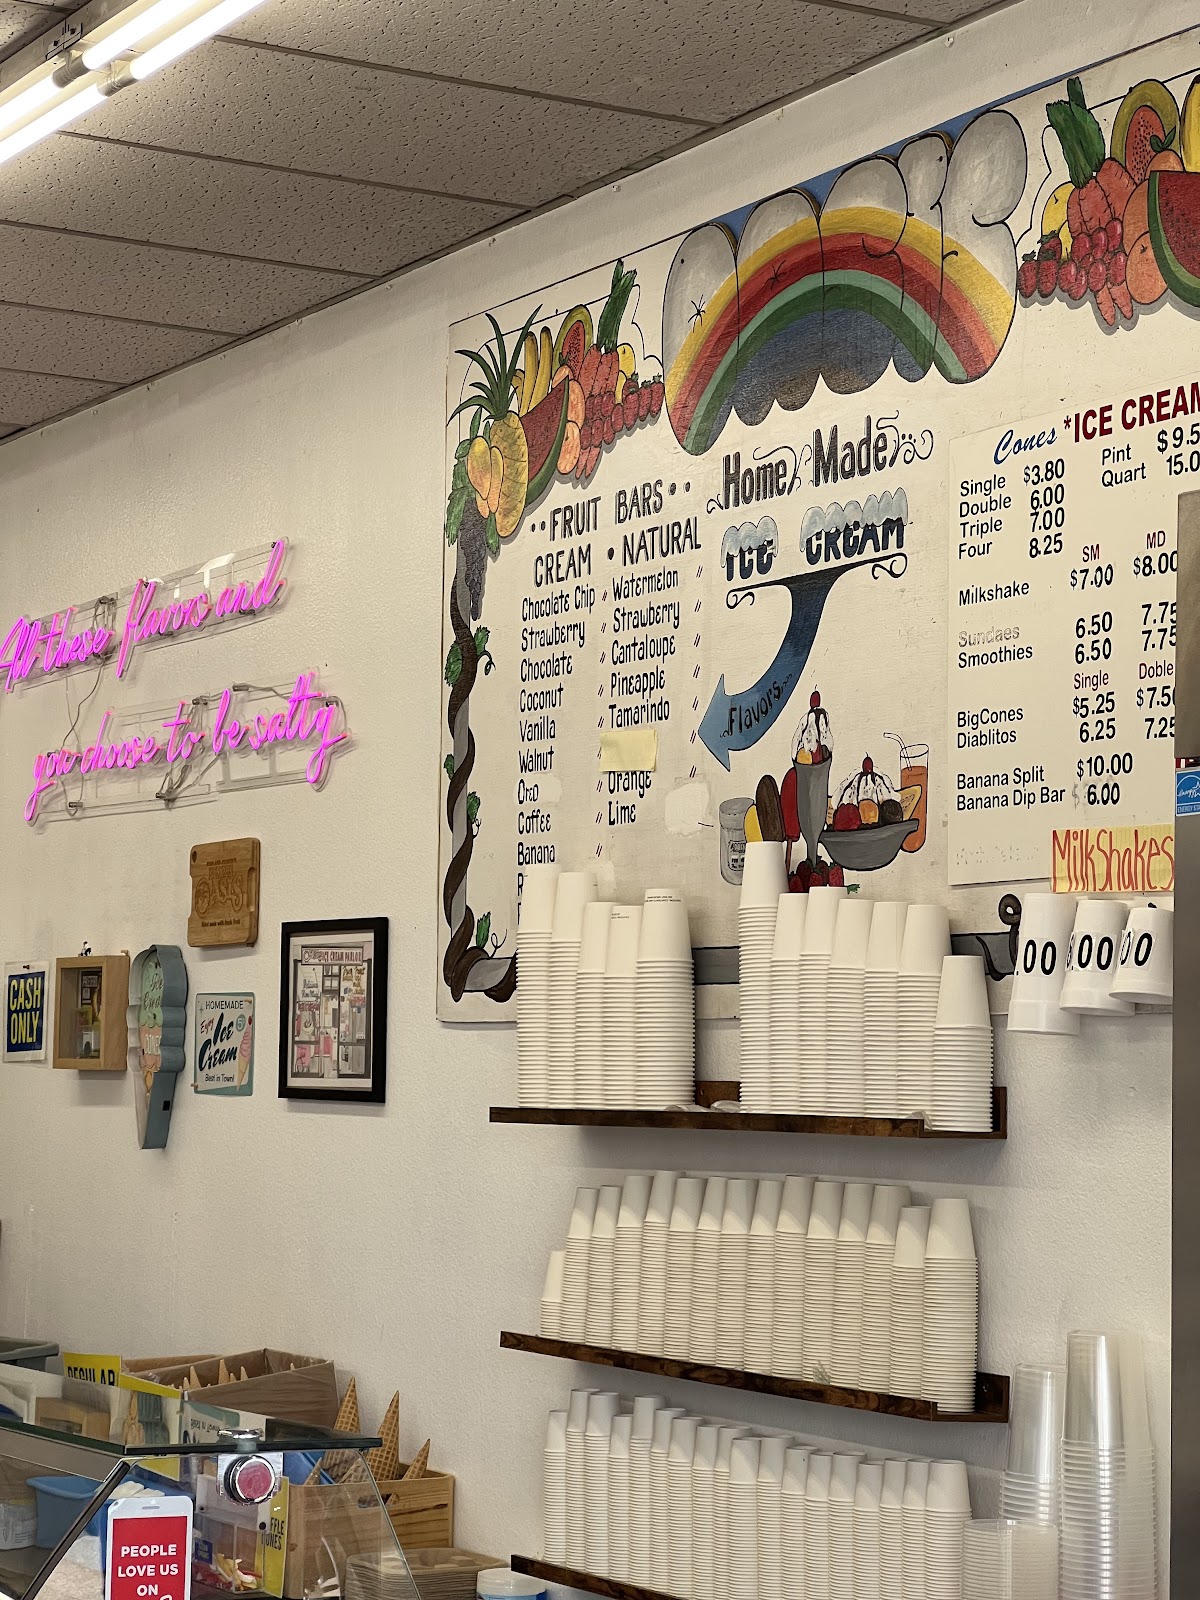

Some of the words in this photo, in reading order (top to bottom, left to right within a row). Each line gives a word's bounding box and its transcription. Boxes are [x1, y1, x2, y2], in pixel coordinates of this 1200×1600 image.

[723, 448, 796, 510] Home
[813, 414, 895, 487] Made
[993, 427, 1058, 465] Cones
[1102, 443, 1132, 466] Pint
[960, 474, 1006, 497] Single
[1024, 458, 1065, 487] $3.80
[1102, 463, 1147, 488] Quart
[550, 496, 602, 541] FRUIT
[615, 479, 663, 525] BARS
[959, 494, 1012, 518] Double
[1030, 484, 1065, 511] 6.00
[960, 517, 1003, 539] Triple
[1030, 507, 1065, 533] 7.00
[622, 516, 702, 566] NATURAL
[722, 526, 776, 582] ICE
[803, 505, 907, 566] CREAM
[958, 540, 993, 560] Four
[1029, 533, 1063, 558] 8.25
[1082, 544, 1100, 563] SM
[1146, 530, 1166, 550] MD
[534, 543, 592, 588] CREAM
[959, 580, 1030, 606] Milkshake
[1070, 564, 1114, 590] $7.00
[1133, 550, 1177, 579] $8.00
[612, 565, 679, 602] Watermelon
[38, 606, 115, 672] these
[116, 577, 213, 679] flavors
[216, 540, 286, 617] and
[522, 590, 570, 622] Chocolate
[574, 583, 596, 614] Chip
[613, 601, 680, 634] Strawberry
[521, 621, 586, 652] Strawberry
[958, 626, 1020, 647] Sundaes
[1076, 611, 1113, 639] 6.50
[611, 634, 676, 666] Cantaloupe
[958, 644, 1034, 668] Smoothies
[1075, 638, 1112, 665] 6.50
[520, 651, 573, 683] Chocolate
[1073, 670, 1109, 691] Single
[1139, 660, 1174, 680] Doble
[519, 684, 564, 713] Coconut
[610, 665, 666, 703] Pineapple
[609, 696, 670, 729] Tamarindo
[727, 681, 781, 737] Flavors
[957, 707, 1024, 731] BigCones
[1073, 691, 1116, 719] $5.25
[1136, 685, 1175, 710] $7.5
[80, 711, 163, 774] choose
[163, 701, 207, 763] to
[212, 688, 251, 753] be
[249, 672, 349, 784] salty
[519, 715, 556, 742] Vanilla
[957, 729, 1017, 749] Diablitos
[1079, 718, 1116, 743] 6.25
[518, 745, 555, 774] Walnut
[957, 771, 1009, 790] Banana
[1013, 765, 1045, 788] Split
[1077, 752, 1133, 780] $10.00
[518, 779, 539, 805] Oreo
[608, 771, 652, 799] Orange
[957, 791, 1009, 811] Banana
[1013, 790, 1036, 809] Dip
[1040, 786, 1066, 805] Bar
[518, 809, 552, 835] Coffee
[608, 801, 636, 826] Lime
[517, 842, 556, 866] Banana
[9, 976, 42, 1011] CASH
[205, 1000, 244, 1010] HOMEMADE
[10, 1011, 40, 1045] ONLY
[213, 1012, 234, 1046] Ice
[198, 1038, 238, 1072] Cream
[271, 1517, 284, 1536] FFLE
[121, 1544, 177, 1557] PEOPLE
[117, 1565, 155, 1578] LOVE
[160, 1564, 179, 1576] US
[136, 1584, 159, 1597] ON
